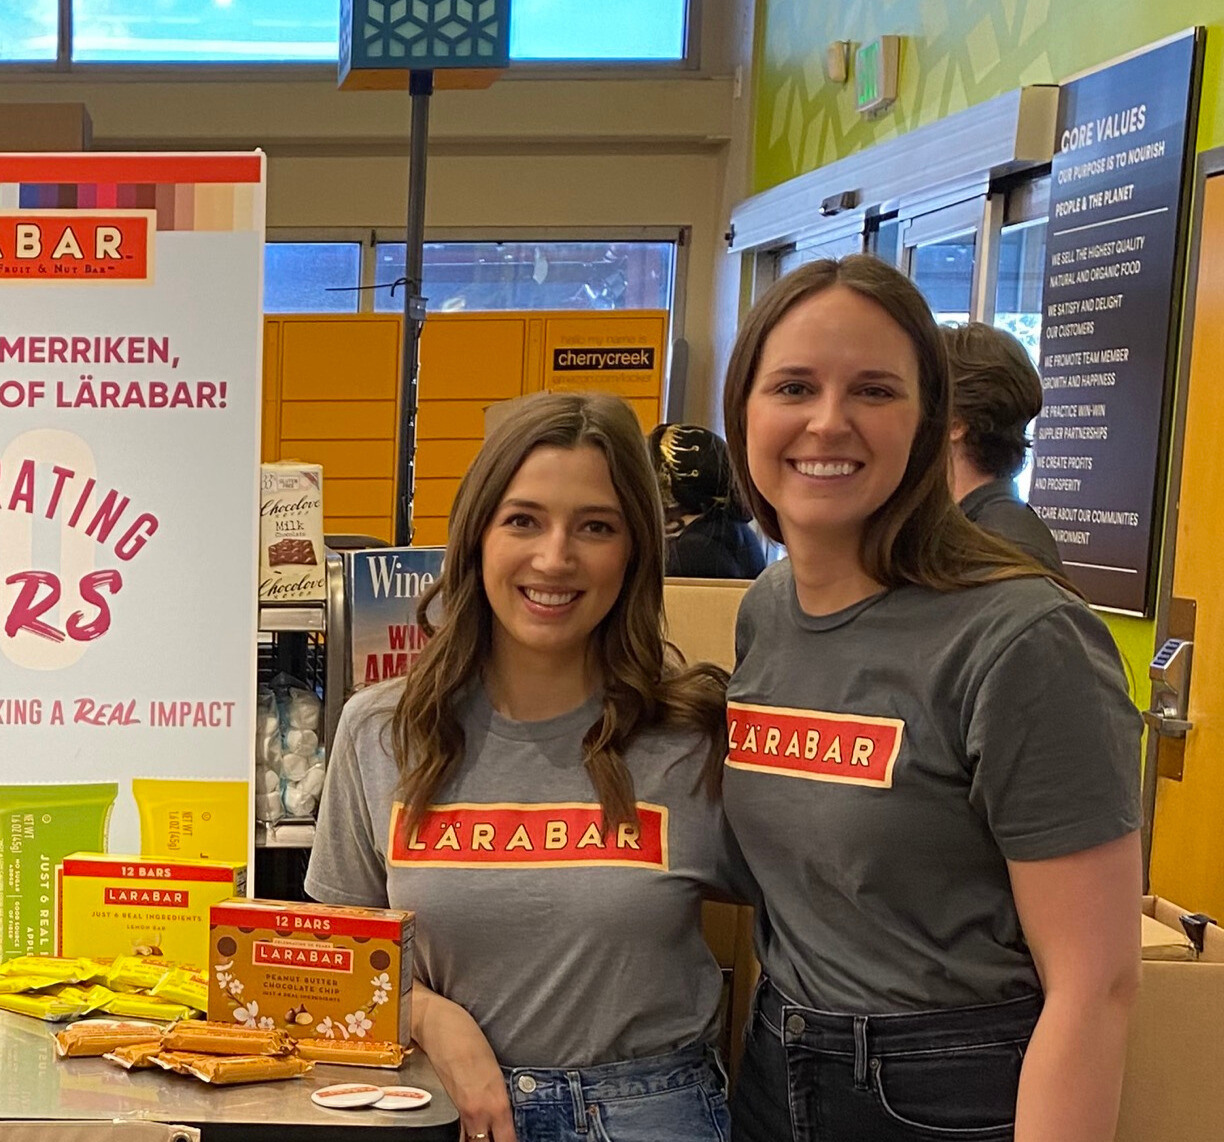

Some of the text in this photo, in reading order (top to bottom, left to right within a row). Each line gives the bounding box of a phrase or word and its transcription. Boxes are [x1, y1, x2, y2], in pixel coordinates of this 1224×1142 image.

[1061, 104, 1146, 153] CORE VALUES
[1058, 141, 1165, 184] OUR PURPOSE IS TO NOURISH
[1055, 184, 1134, 218] PEOPLE & THE PLANET
[1087, 241, 1116, 258] HIGHEST
[1116, 236, 1146, 254] QUALITY
[1049, 260, 1141, 288] NATURAL AND ORGANIC FOOD
[1094, 294, 1123, 311] DELIGHT
[1058, 321, 1095, 338] CUSTOMERS
[558, 349, 649, 369] cherrycreek
[1054, 348, 1129, 367] PROMOTE TEAM MEMBER
[1081, 372, 1116, 387] HAPPINESS
[56, 374, 227, 409] LÄRABAR!
[1063, 426, 1108, 440] PARTNERSHIPS
[1046, 456, 1093, 470] CREATE PROFITS
[1047, 479, 1081, 492] PROSPERITY
[261, 495, 321, 517] Chocolove
[275, 520, 305, 531] Milk
[1042, 507, 1057, 520] CARE
[1057, 507, 1077, 521] ABOUT
[1092, 510, 1139, 527] COMMUNITIES
[259, 573, 325, 597] Chocolove
[366, 555, 434, 599] Wine
[50, 699, 64, 726] A
[73, 697, 141, 726] REAL
[150, 700, 236, 728] IMPACT
[728, 720, 875, 767] LÄRABAR
[408, 820, 640, 851] LÄRABAR
[40, 854, 50, 889] JUST
[121, 866, 172, 878] 12 BARS
[40, 894, 50, 903] 6
[122, 912, 142, 920] REAL
[146, 913, 202, 922] INGREDIENTS
[275, 915, 331, 930] 12 BARS
[39, 909, 49, 946] REAL
[263, 982, 341, 995] CHOCOLATE CHIP
[265, 973, 338, 987] PEANUT BUTTER
